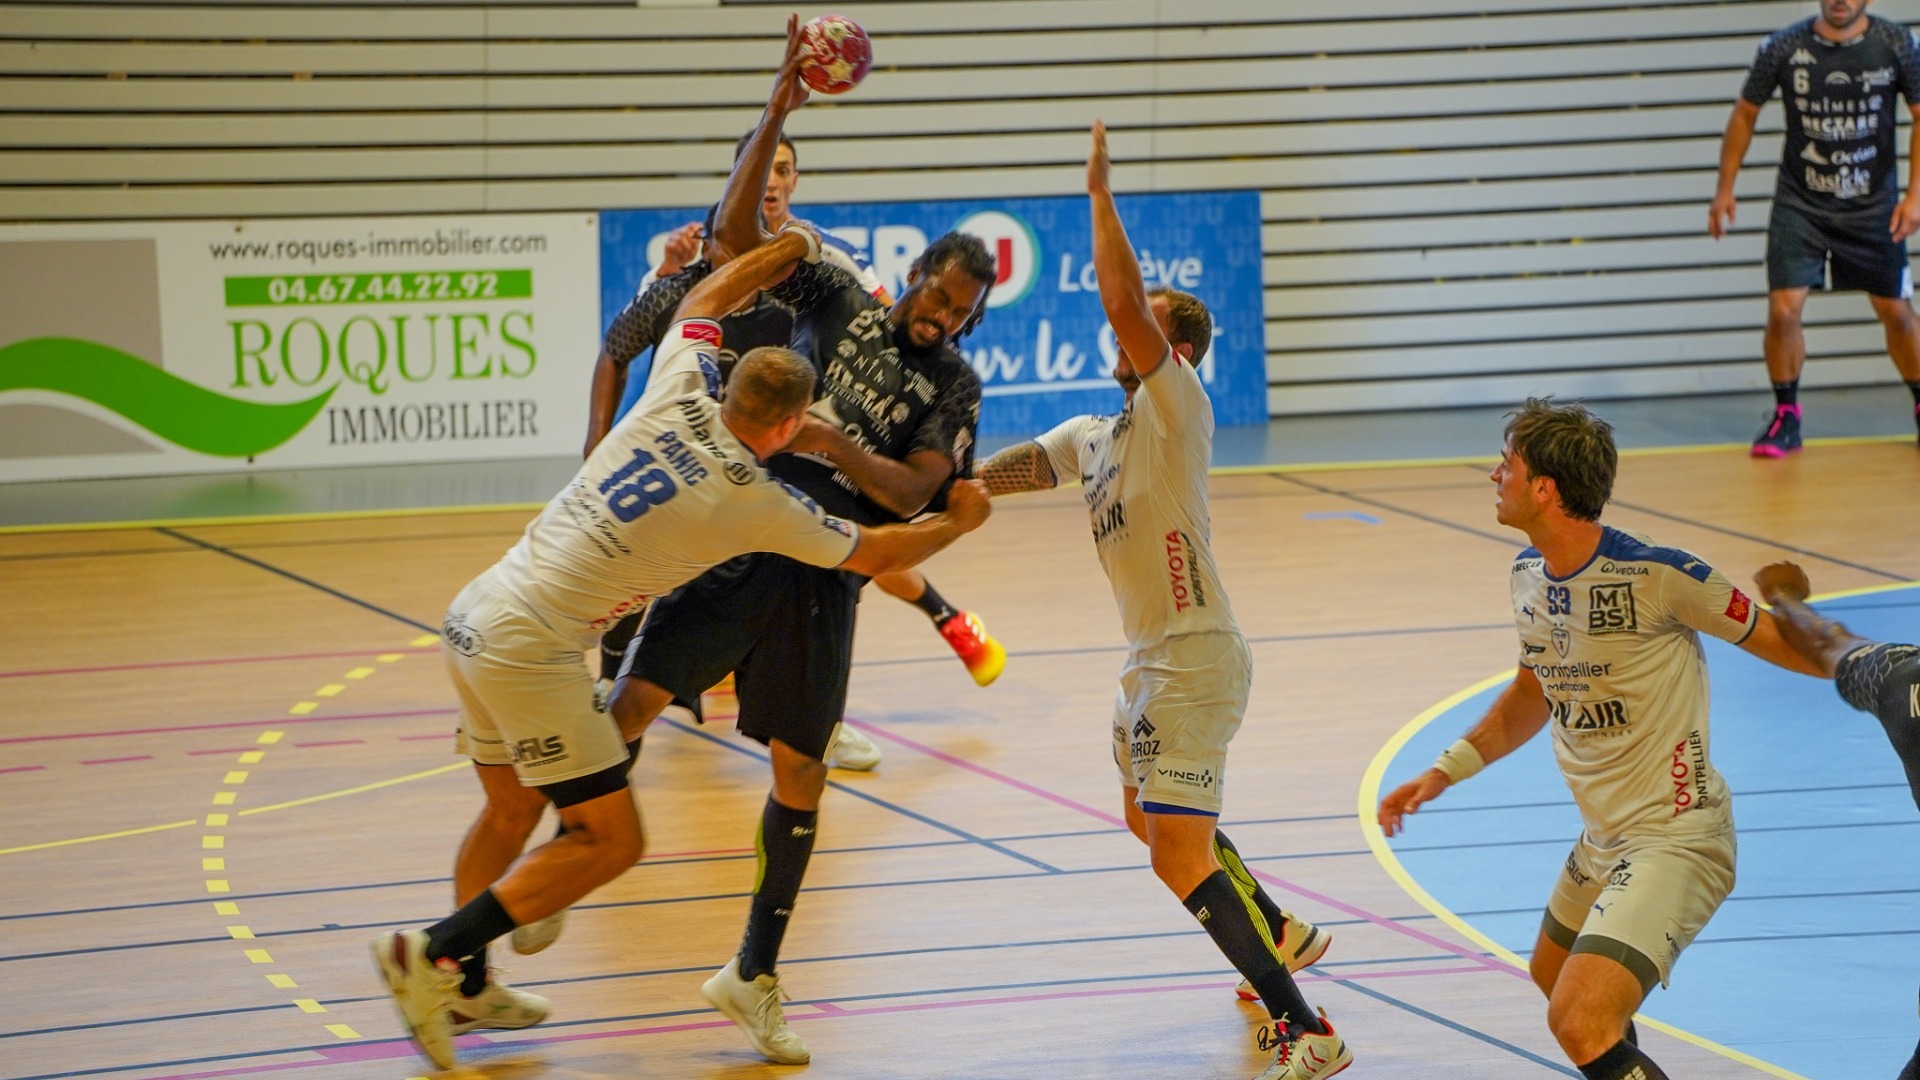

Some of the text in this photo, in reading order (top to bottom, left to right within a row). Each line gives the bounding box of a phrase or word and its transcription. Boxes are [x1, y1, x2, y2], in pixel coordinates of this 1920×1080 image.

[1793, 68, 1810, 95] 6
[209, 228, 548, 264] www.roques-immobilier.com
[268, 272, 499, 304] 04.67.44.22.92
[846, 309, 883, 342] 27
[228, 310, 538, 395] ROQUES
[1035, 319, 1087, 383] le
[329, 400, 539, 446] IMMOBILIER
[654, 430, 709, 487] PANIC
[598, 447, 679, 523] 18
[1165, 529, 1191, 613] TOYOTA
[1615, 564, 1650, 576] VEOLIA
[1547, 585, 1571, 616] 93
[1157, 768, 1200, 782] VINCI
[1671, 739, 1692, 817] TOYOTA
